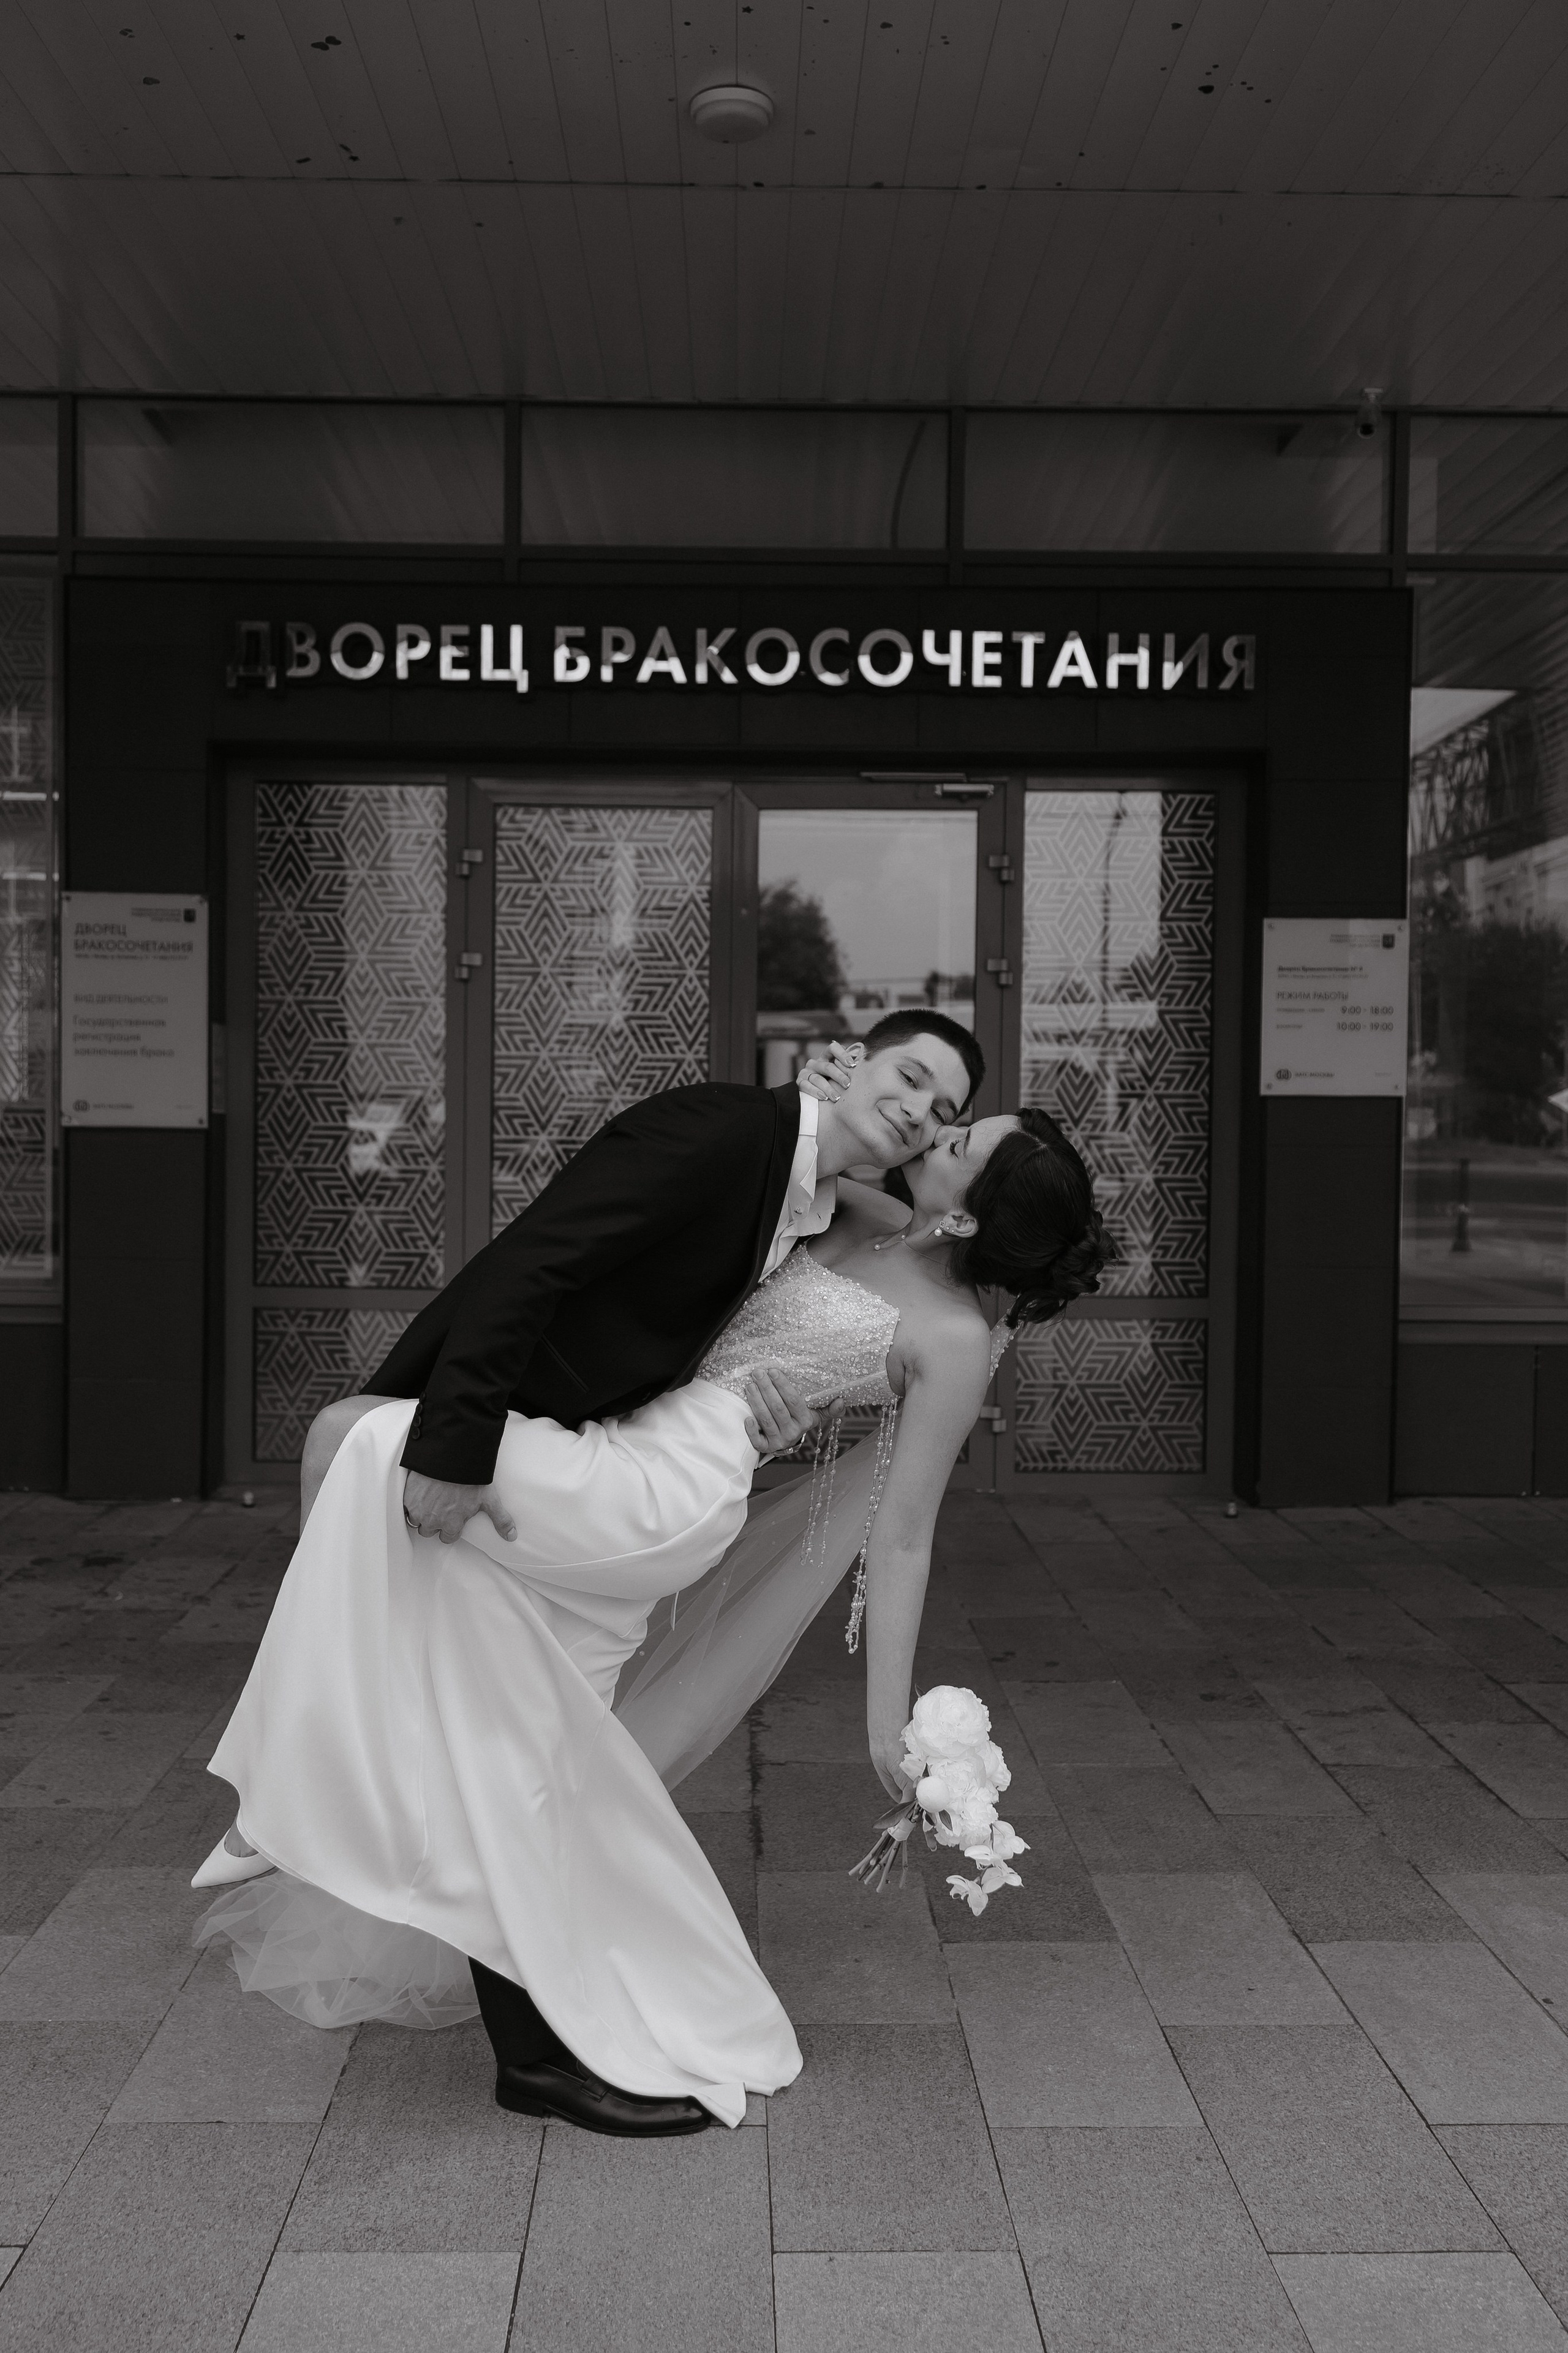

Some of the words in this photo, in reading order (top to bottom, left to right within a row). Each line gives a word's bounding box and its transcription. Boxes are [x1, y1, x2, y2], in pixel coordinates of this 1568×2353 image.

[226, 621, 528, 693] ДВОРЕЦ
[554, 626, 1256, 690] БРАКОСОЧЕТАНИЯ
[74, 923, 127, 937] ДВОРЕЦ
[74, 939, 193, 952] БРАКОСОЧЕТАНИЯ
[1276, 991, 1311, 1000] РЕЖИМ
[1312, 991, 1349, 1001] РАБОТЫ
[1341, 1005, 1362, 1015] 9:00
[1370, 1005, 1394, 1015] 18:00
[1336, 1022, 1361, 1032] 10:00
[1370, 1022, 1394, 1032] 19:00
